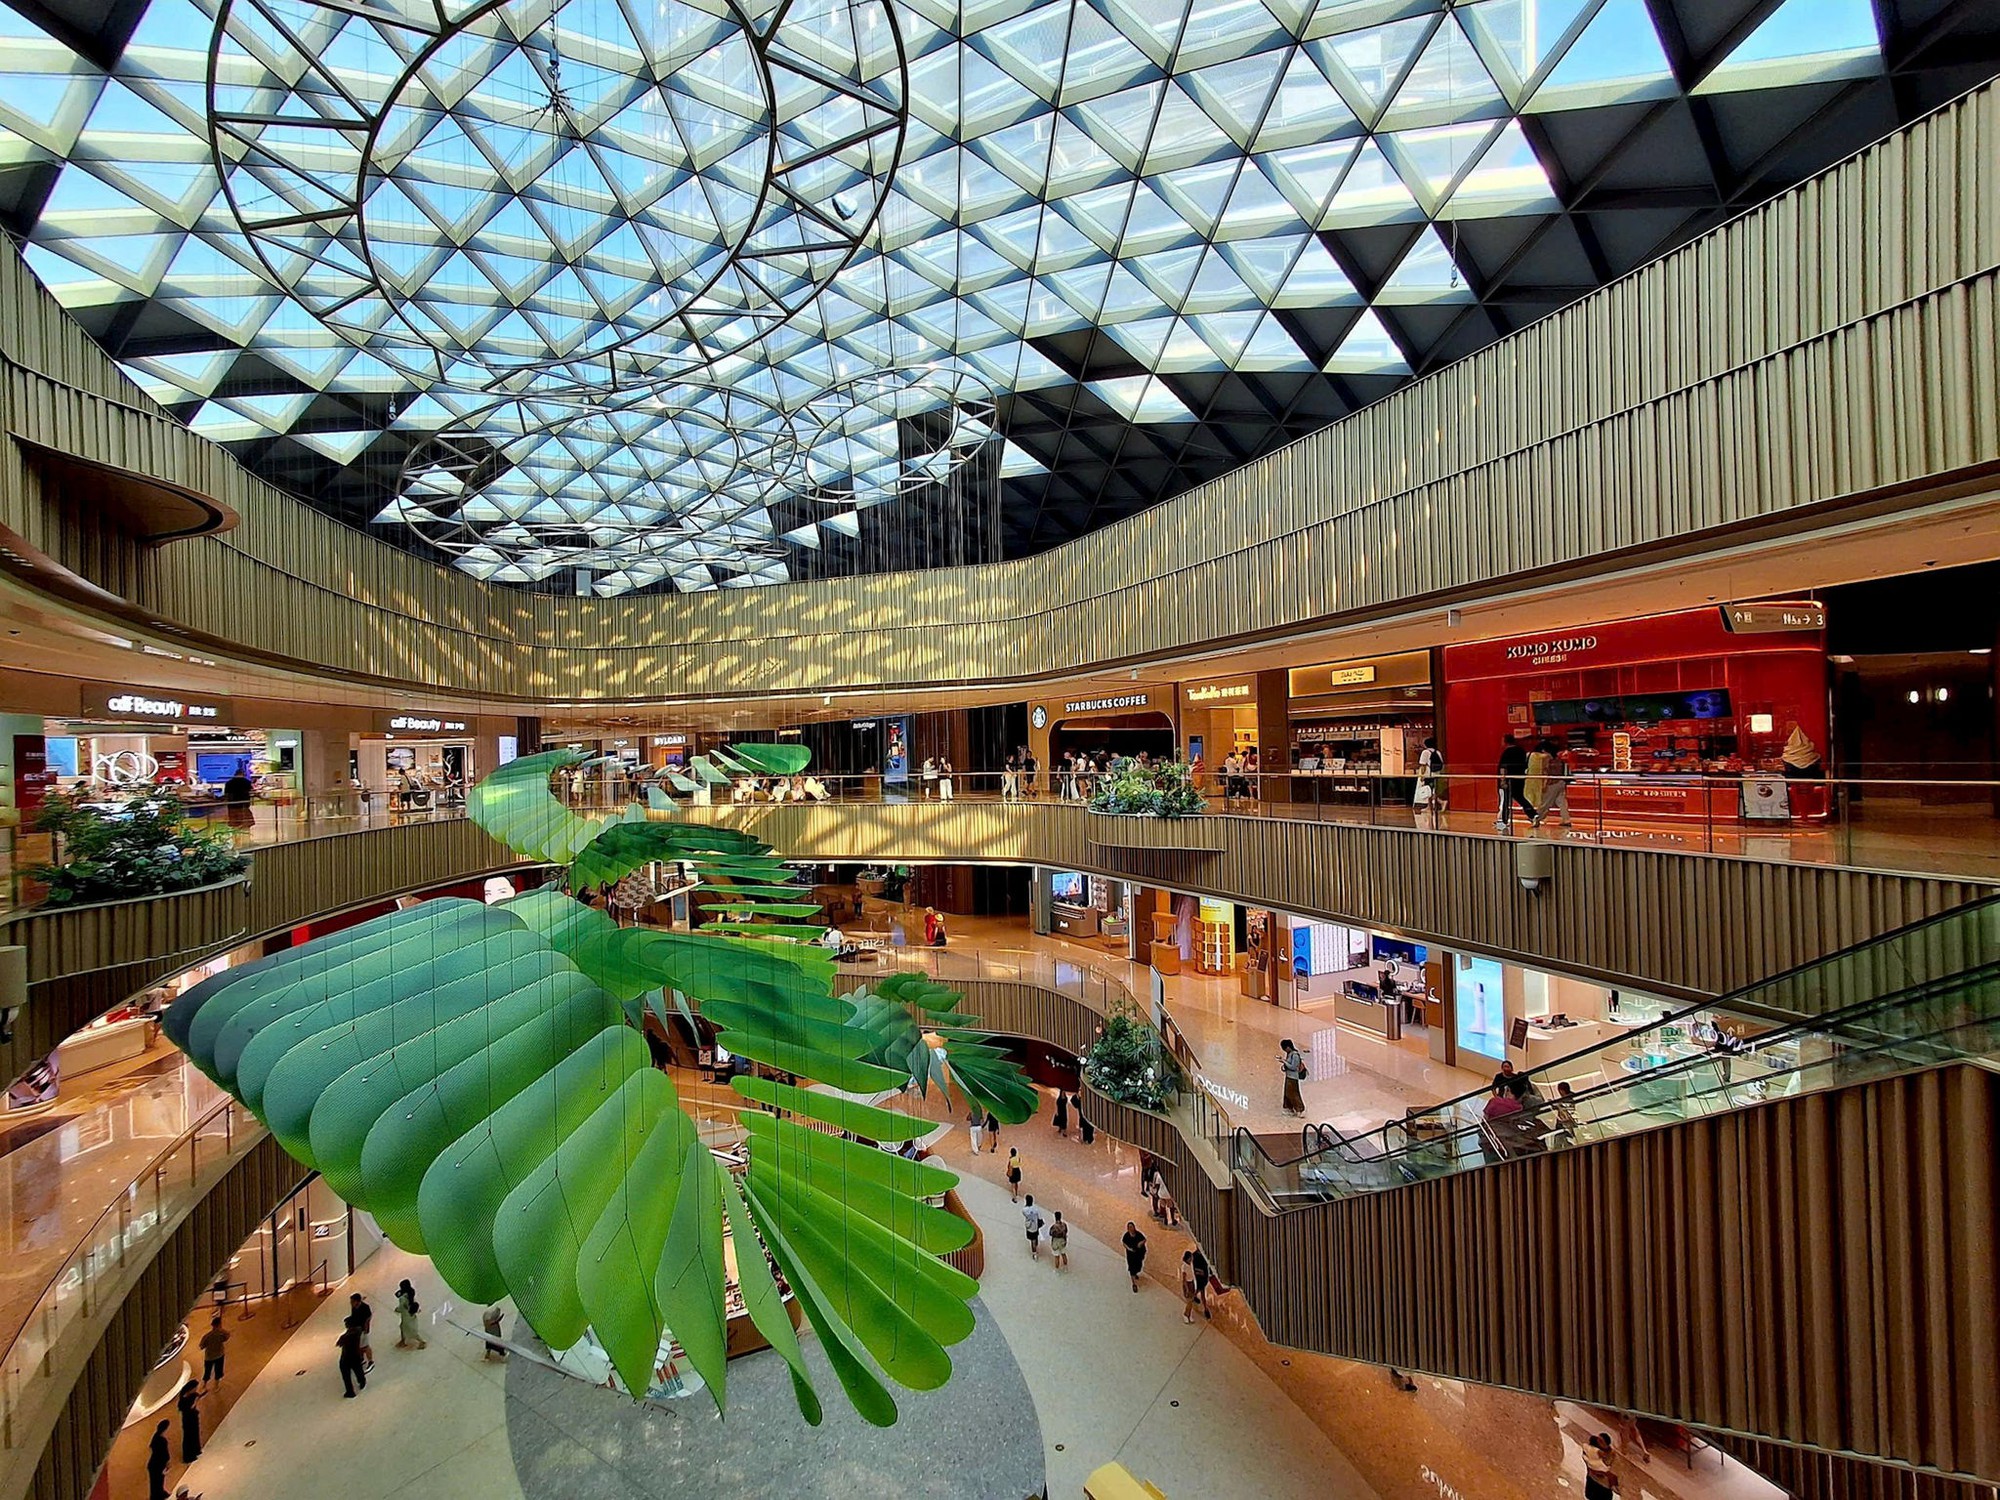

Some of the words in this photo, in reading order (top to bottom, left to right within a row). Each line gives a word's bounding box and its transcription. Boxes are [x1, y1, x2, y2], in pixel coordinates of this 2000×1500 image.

[1507, 643, 1549, 659] KUMO
[1551, 636, 1597, 653] KUMO
[134, 696, 182, 718] Beauty
[1065, 699, 1113, 713] STARBUCKS
[1113, 694, 1147, 708] COFFEE
[407, 717, 441, 732] Beauty
